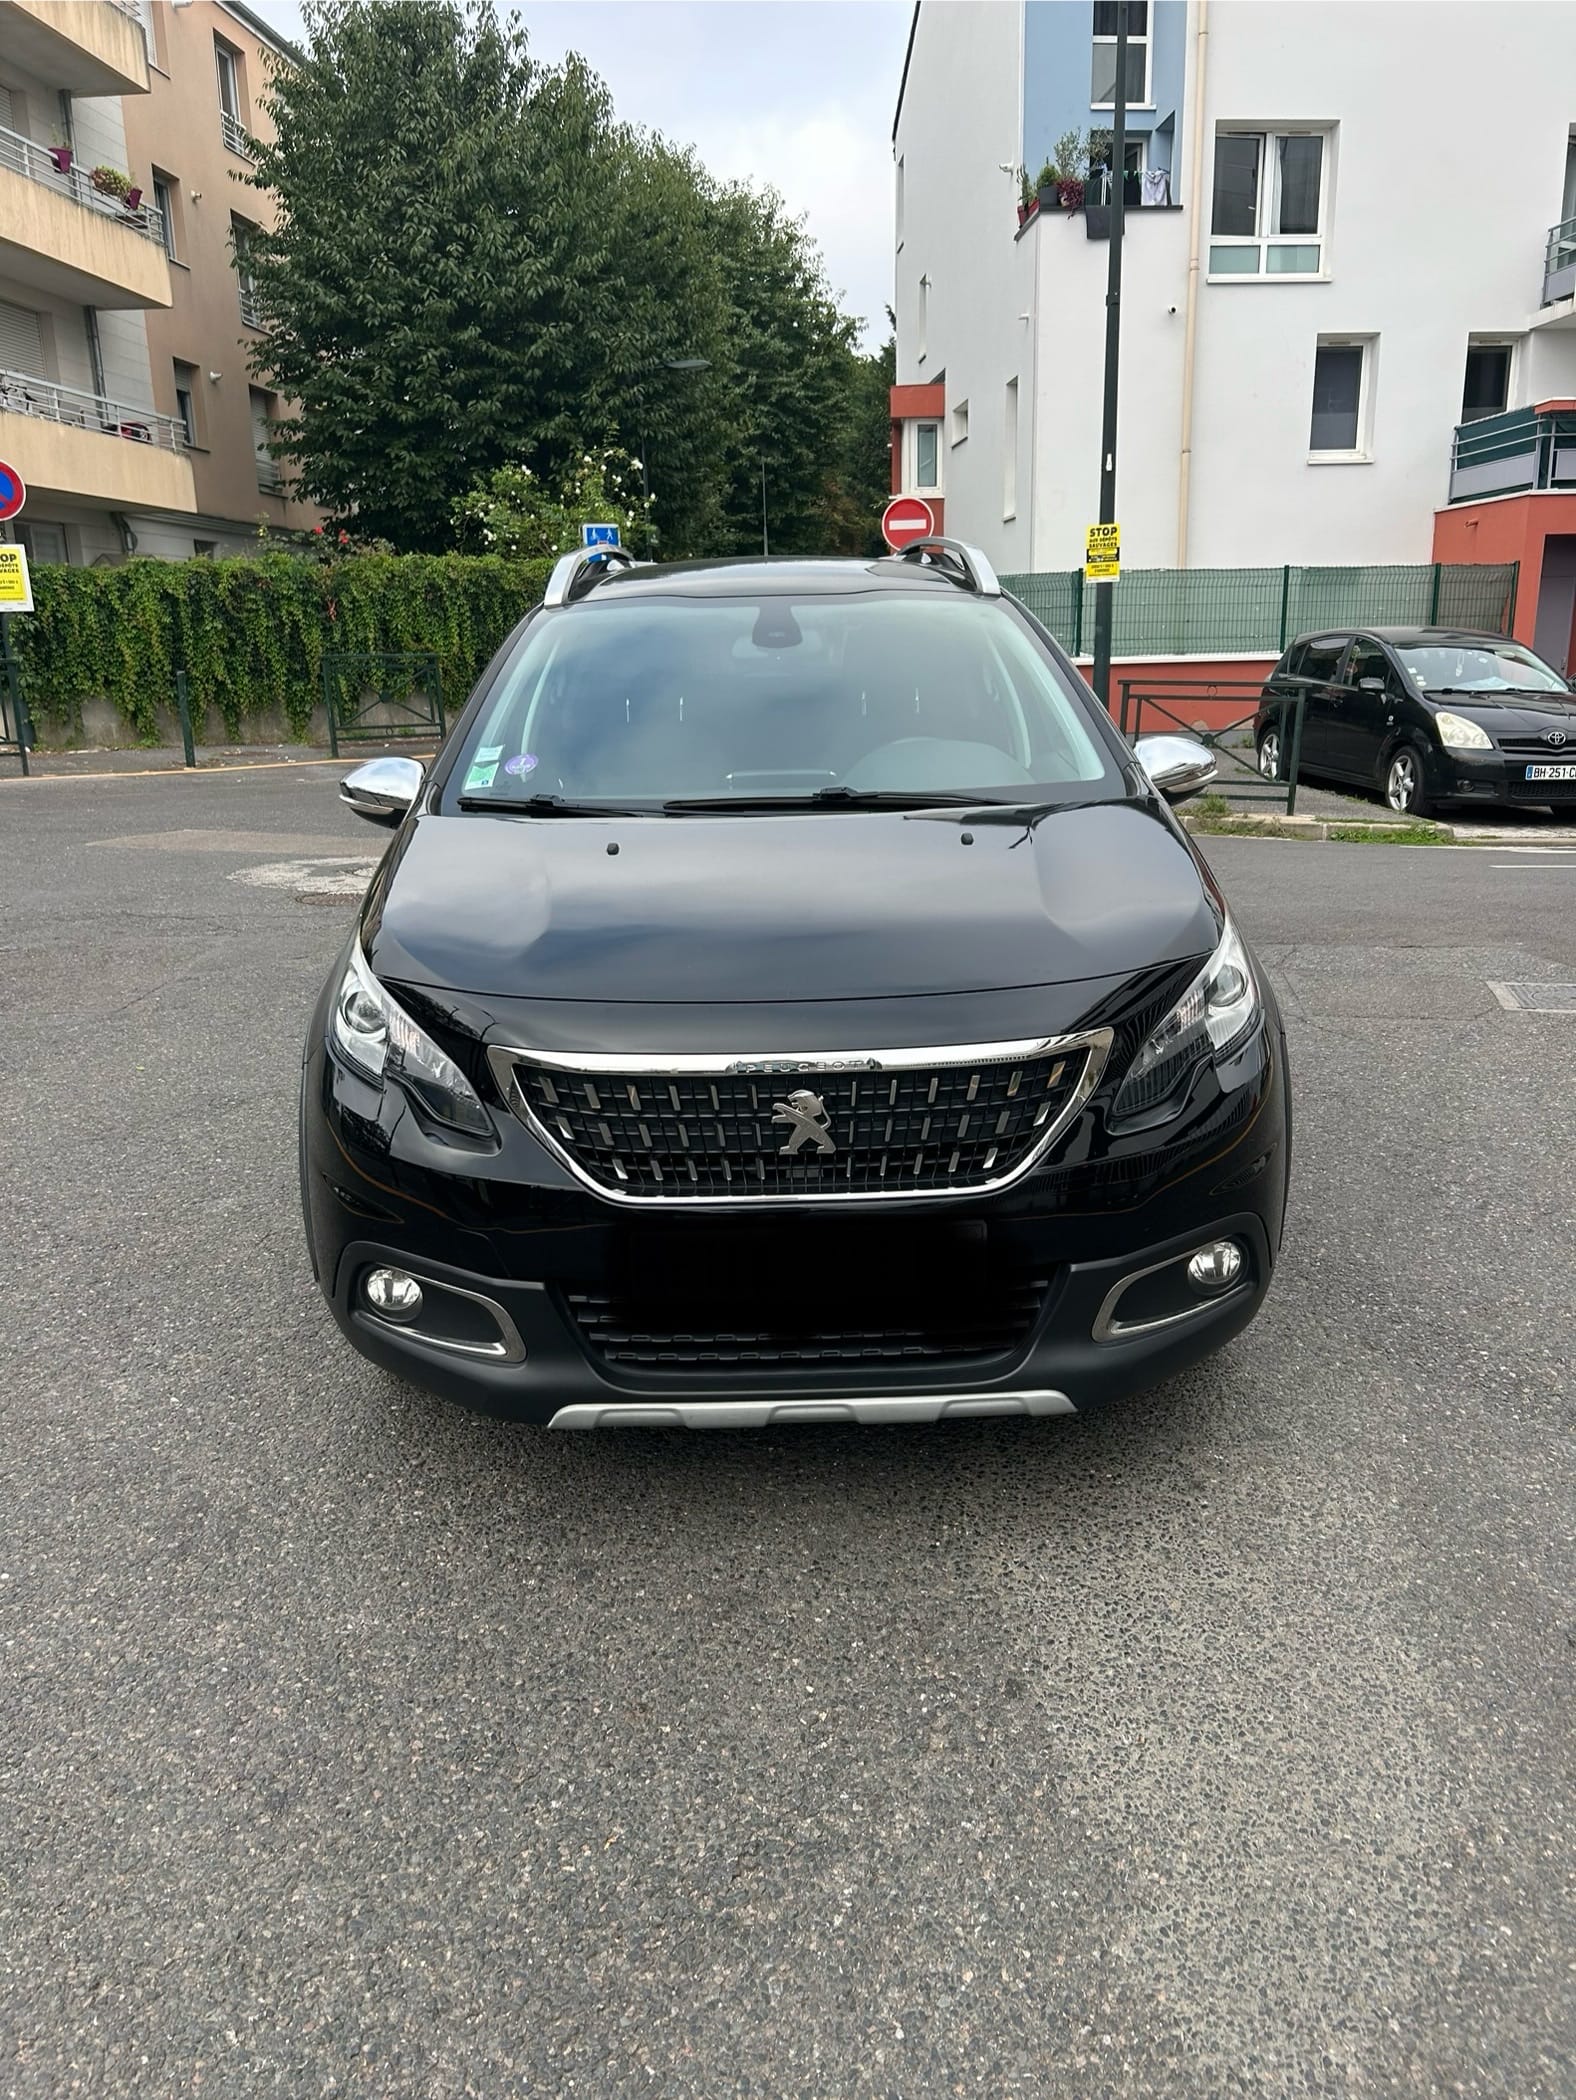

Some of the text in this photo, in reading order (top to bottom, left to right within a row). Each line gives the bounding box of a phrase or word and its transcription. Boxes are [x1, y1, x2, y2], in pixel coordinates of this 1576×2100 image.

[1089, 527, 1117, 537] STOP
[1534, 767, 1576, 778] BH-251-C
[745, 1060, 864, 1073] PEUGEOT
